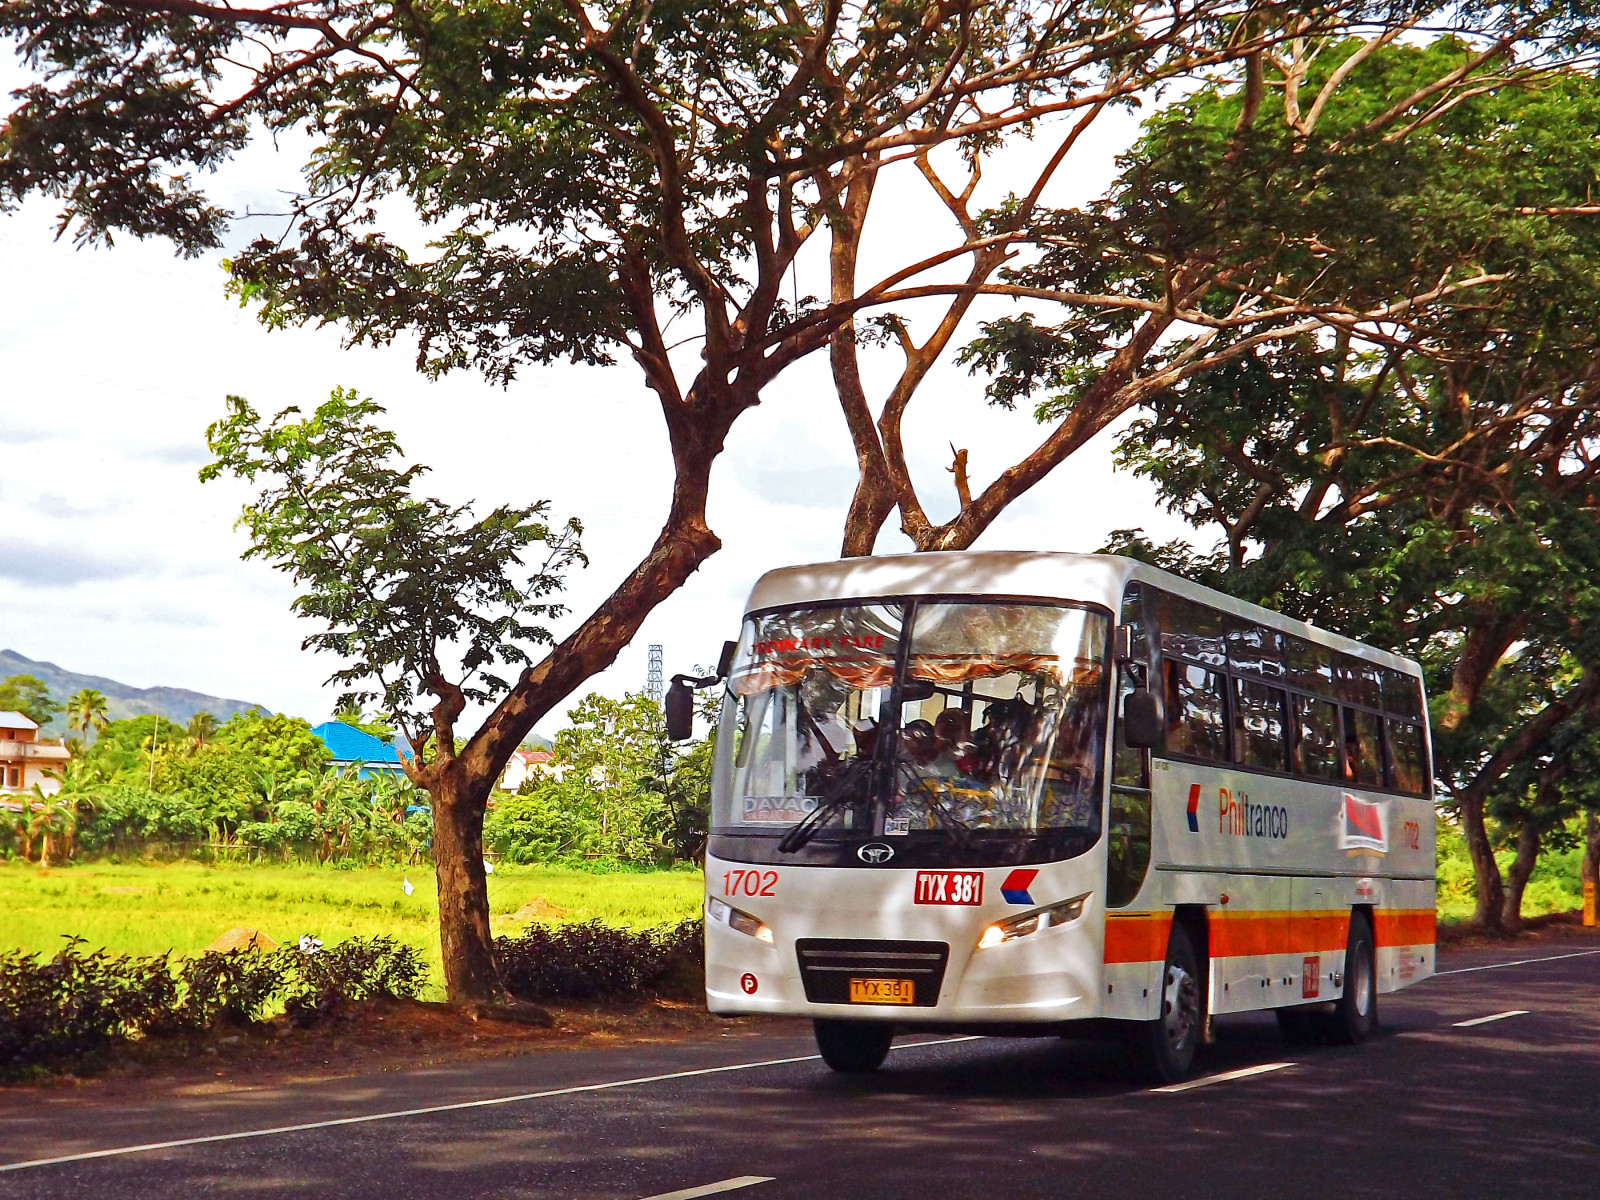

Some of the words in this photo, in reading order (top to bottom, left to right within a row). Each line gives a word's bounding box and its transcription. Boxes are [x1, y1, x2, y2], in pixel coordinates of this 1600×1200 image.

[840, 635, 884, 650] FARE
[744, 798, 817, 813] DAVAO
[1219, 787, 1288, 839] Philtranco
[724, 870, 778, 897] 1702
[919, 875, 949, 901] TYX
[951, 875, 981, 902] 381
